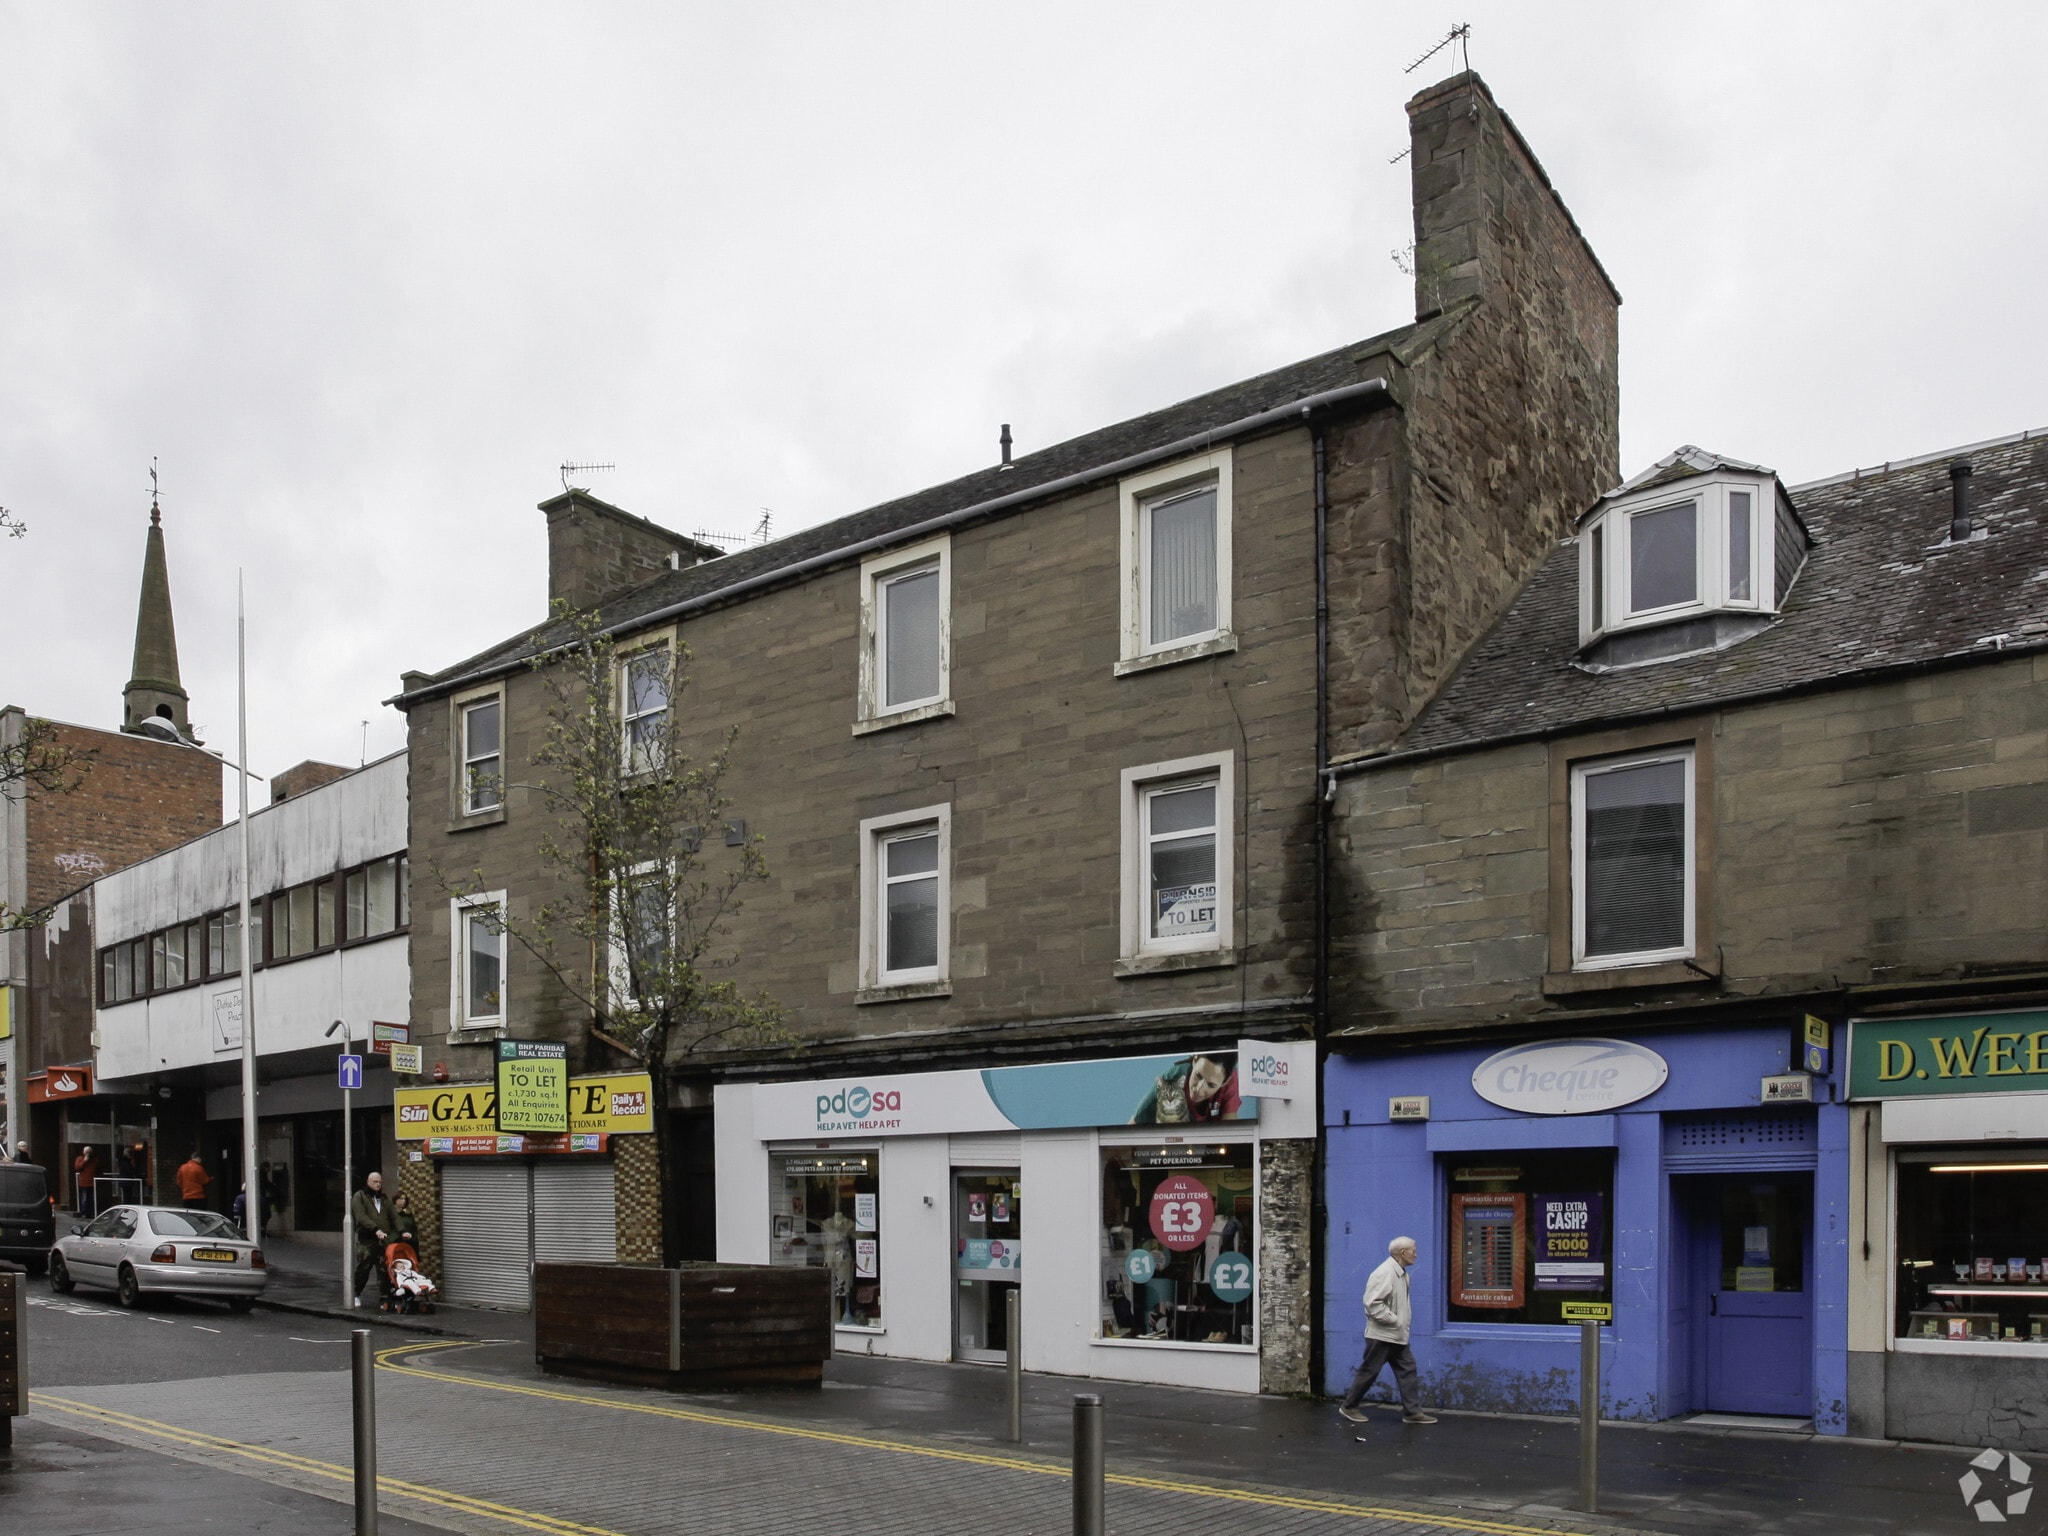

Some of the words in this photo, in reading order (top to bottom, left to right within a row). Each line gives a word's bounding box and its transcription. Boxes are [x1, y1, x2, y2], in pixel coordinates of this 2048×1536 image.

[1168, 911, 1185, 925] TO
[1191, 907, 1215, 922] LET
[535, 1044, 565, 1052] PARIBAS
[511, 1065, 535, 1073] Retail
[538, 1065, 554, 1073] Unit
[509, 1074, 529, 1086] TO
[536, 1075, 557, 1087] LET
[1497, 1064, 1619, 1101] Cheque
[508, 1090, 536, 1098] c.1,730
[612, 1094, 634, 1106] Daily
[1576, 1090, 1614, 1101] centre
[522, 1100, 559, 1109] Enquiries
[612, 1103, 645, 1115] Record
[400, 1106, 428, 1121] Sun
[502, 1111, 530, 1122] 07872
[534, 1113, 565, 1123] 107674
[431, 1125, 449, 1133] NEWS
[453, 1124, 471, 1132] MAGS
[817, 1122, 835, 1131] HELP
[836, 1122, 842, 1130] A
[842, 1121, 857, 1130] VET
[859, 1121, 878, 1129] HELP
[879, 1120, 885, 1128] A
[886, 1119, 901, 1128] PET
[430, 1139, 452, 1148] Scot-Ads
[498, 1138, 521, 1147] Scot-Ads
[572, 1137, 597, 1146] Scot-Ads
[1546, 1202, 1563, 1211] NEED
[1565, 1202, 1587, 1211] EXTRA
[1160, 1202, 1202, 1232] £3
[1546, 1212, 1588, 1229] CASH?
[1547, 1239, 1589, 1250] £1000
[1129, 1255, 1151, 1275] £1
[1214, 1263, 1250, 1289] £2
